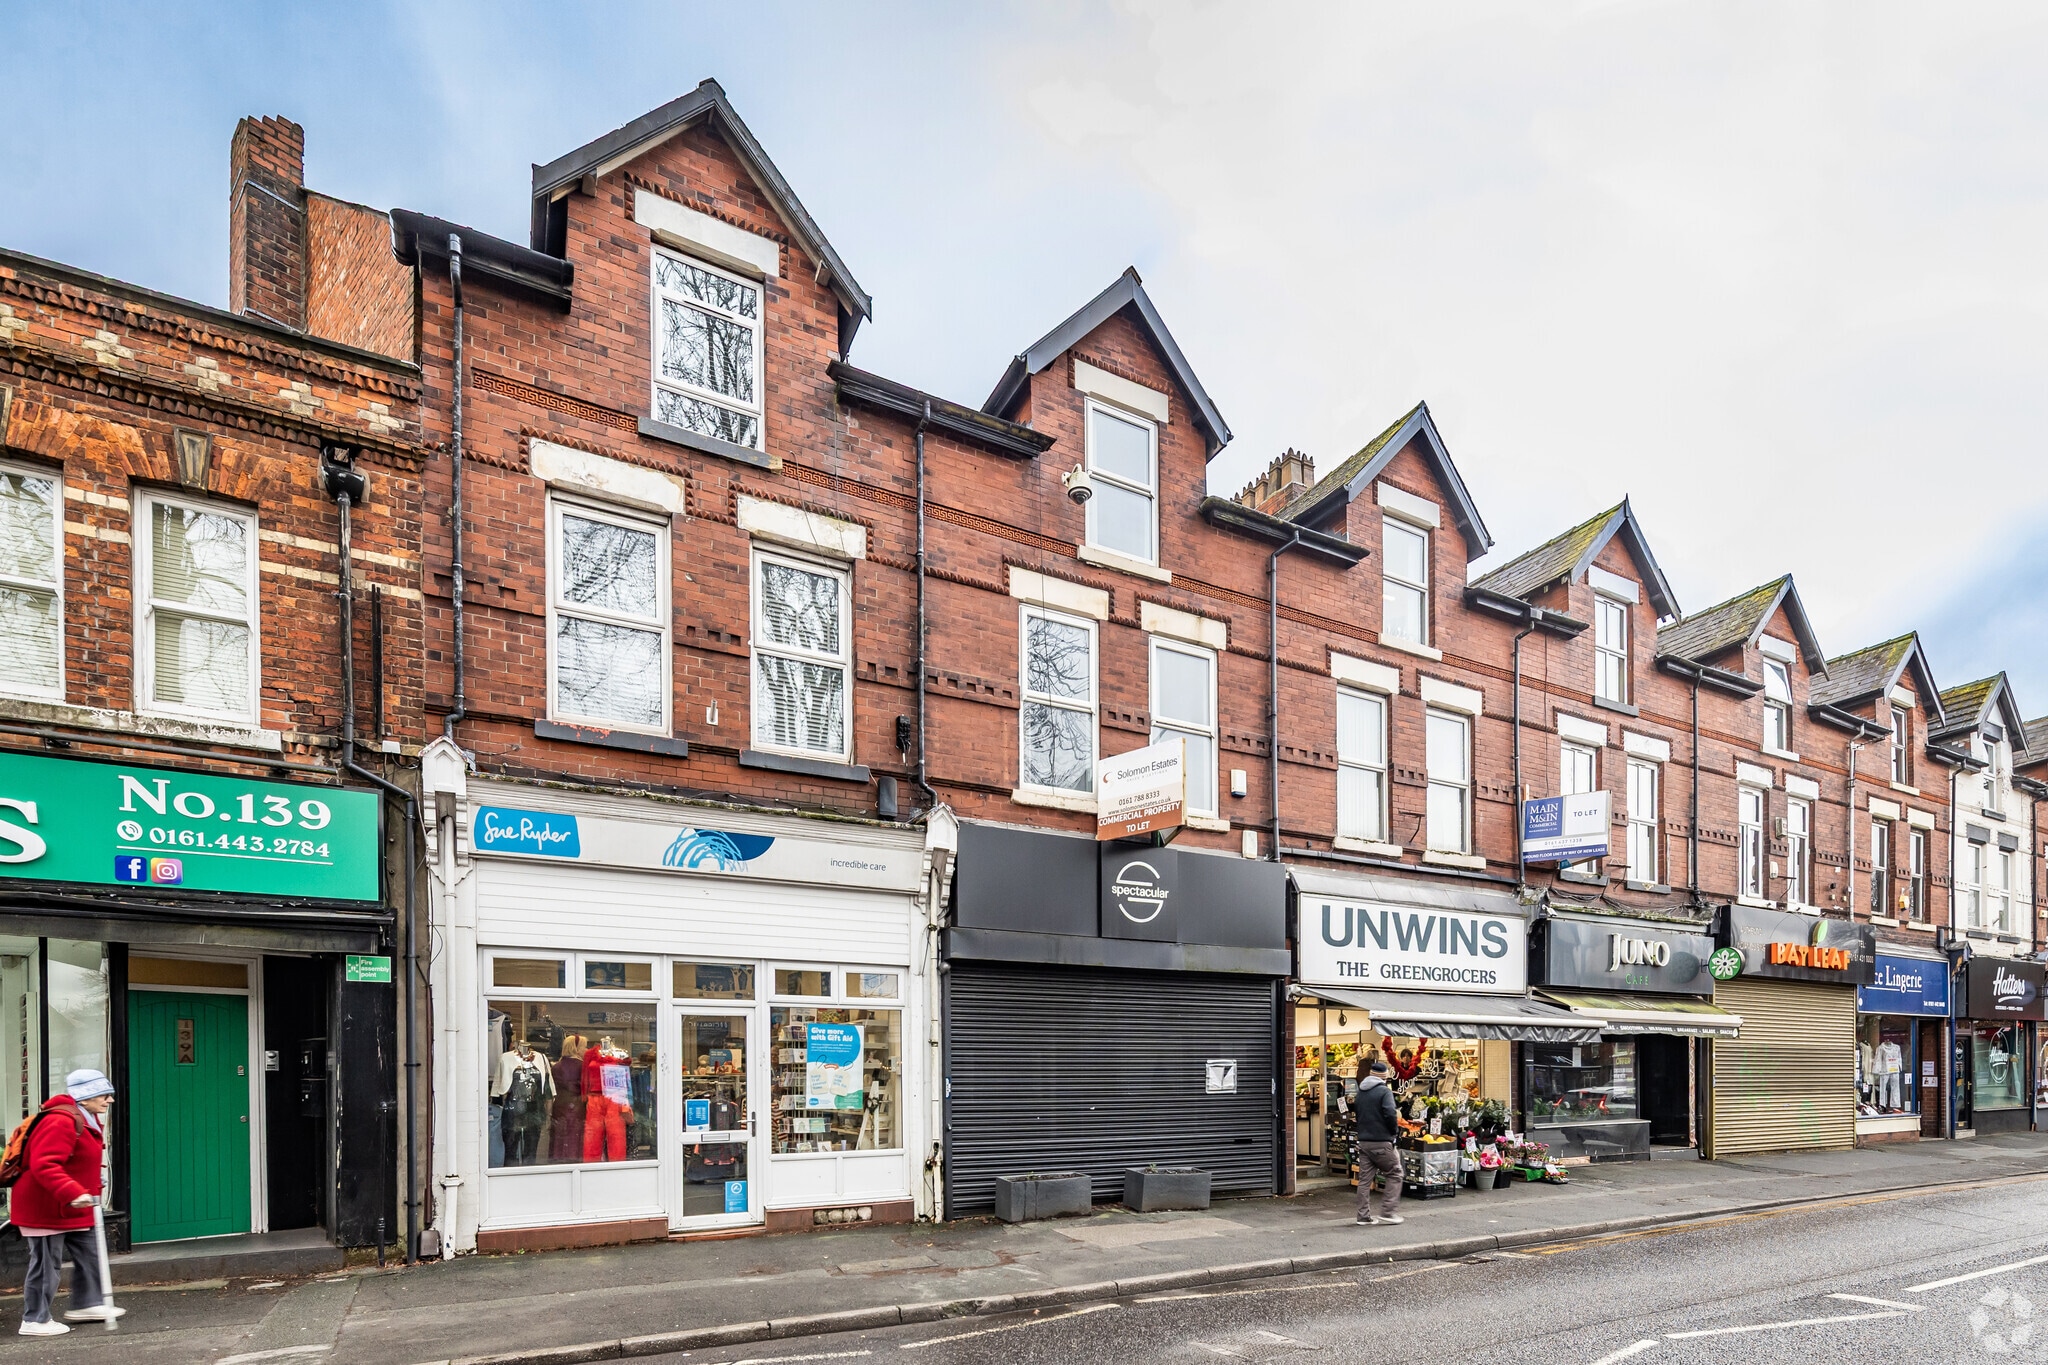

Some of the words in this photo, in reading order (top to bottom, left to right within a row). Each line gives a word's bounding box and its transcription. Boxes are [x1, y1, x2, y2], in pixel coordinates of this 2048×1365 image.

[1117, 764, 1150, 780] Solomon
[1151, 757, 1178, 771] Estates
[116, 774, 332, 831] No.139
[1098, 810, 1143, 827] COMMERCIAL
[1143, 801, 1181, 816] PROPERTY
[1119, 796, 1133, 806] 0161
[1529, 802, 1559, 815] MAIN
[483, 812, 519, 843] Sue
[519, 817, 571, 851] Ryder
[1126, 824, 1136, 832] TO
[1137, 820, 1150, 831] LET
[1528, 821, 1558, 829] COMMERCIAL
[148, 826, 330, 858] 0161.443.2784
[830, 857, 867, 870] incredible
[869, 862, 887, 872] care
[1111, 885, 1170, 899] spectacular
[1321, 904, 1509, 959] UNWINS
[1609, 932, 1671, 972] JUNO
[1771, 942, 1809, 967] BAY
[1809, 946, 1852, 971] LEAF
[1336, 960, 1370, 978] THE
[1380, 962, 1497, 985] GREENGROCERS
[1874, 971, 1883, 985] ce
[1885, 964, 1923, 994] Lingerie
[1992, 966, 2025, 996] Hatters
